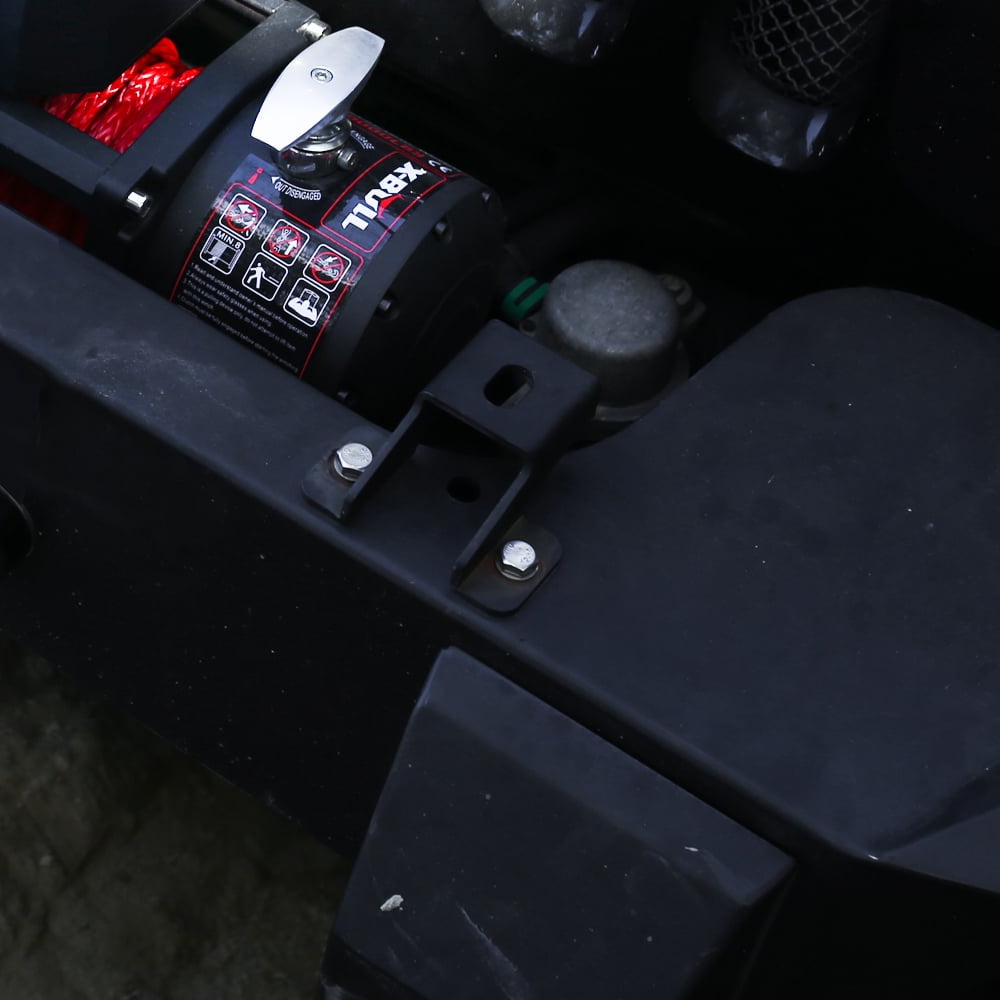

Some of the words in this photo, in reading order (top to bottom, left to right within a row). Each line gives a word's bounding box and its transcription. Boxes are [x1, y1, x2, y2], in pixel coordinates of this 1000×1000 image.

[274, 181, 288, 193] OUT
[285, 187, 322, 201] DISENGAGED
[341, 161, 428, 231] X-BULL
